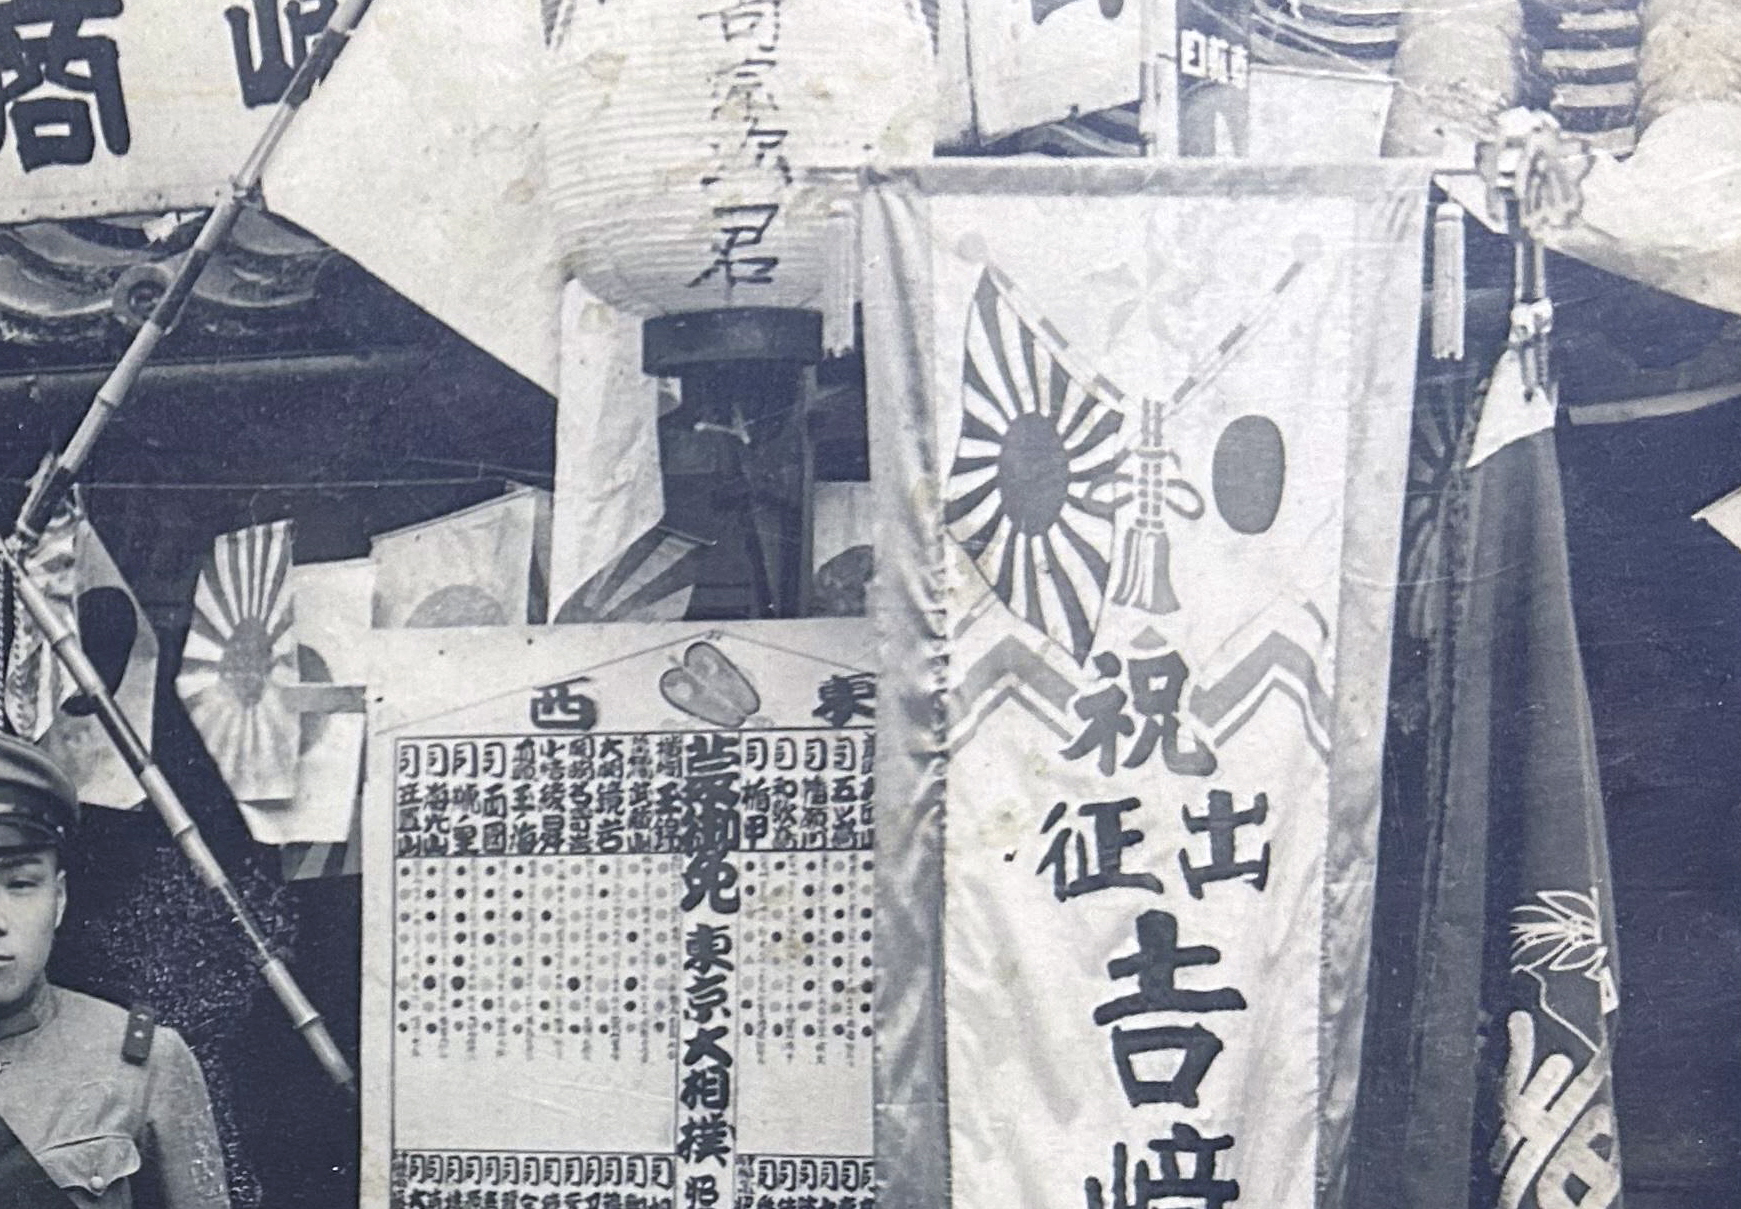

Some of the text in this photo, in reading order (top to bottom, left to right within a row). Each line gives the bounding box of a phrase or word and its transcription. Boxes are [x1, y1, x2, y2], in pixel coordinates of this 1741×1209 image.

[530, 677, 598, 731] 西
[812, 671, 875, 728] 東
[1061, 648, 1216, 777] 祝
[1037, 788, 1271, 902] 出征
[677, 923, 736, 1167] 東京大相撲
